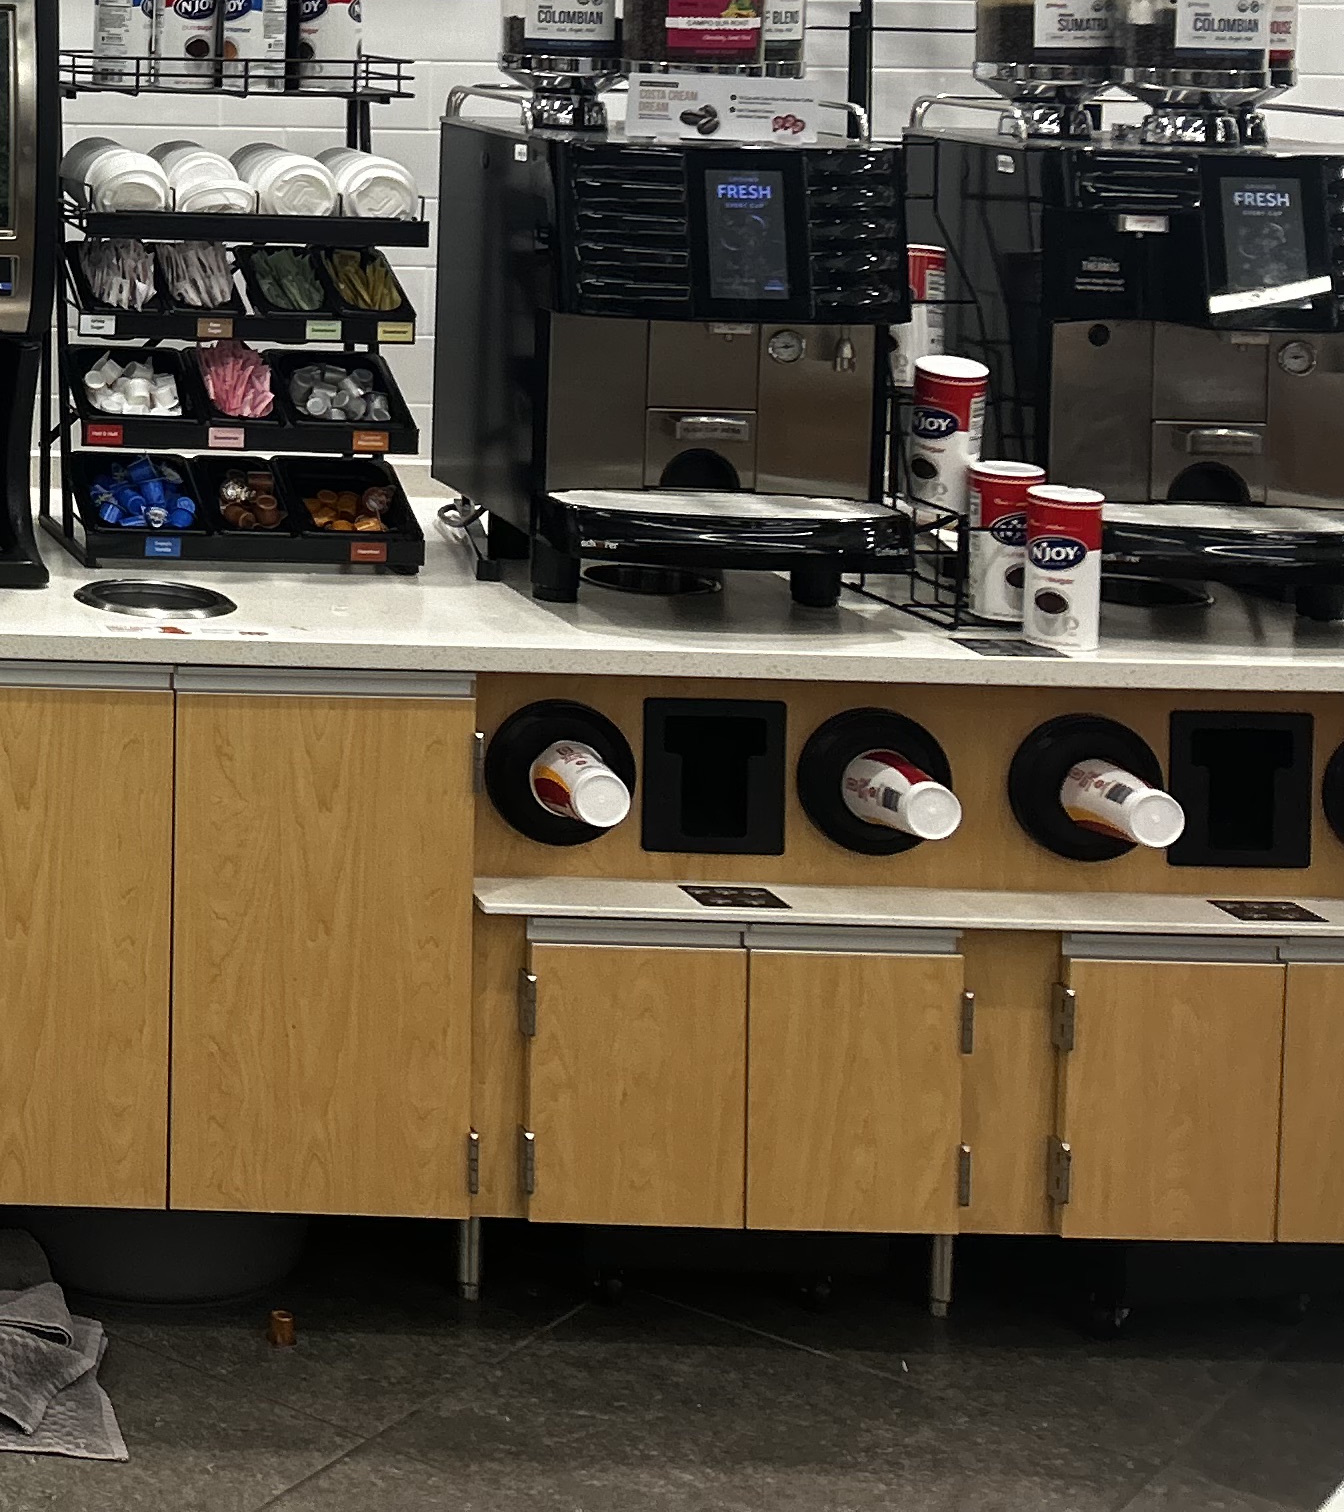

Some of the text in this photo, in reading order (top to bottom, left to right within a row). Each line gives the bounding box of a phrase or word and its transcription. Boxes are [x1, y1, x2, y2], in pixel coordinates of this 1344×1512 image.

[538, 10, 603, 24] COLOMBIAN
[1193, 17, 1259, 33] COLOMBIAN
[1270, 21, 1292, 34] OUSE
[717, 184, 771, 199] FRESH
[1233, 192, 1290, 207] FRESH
